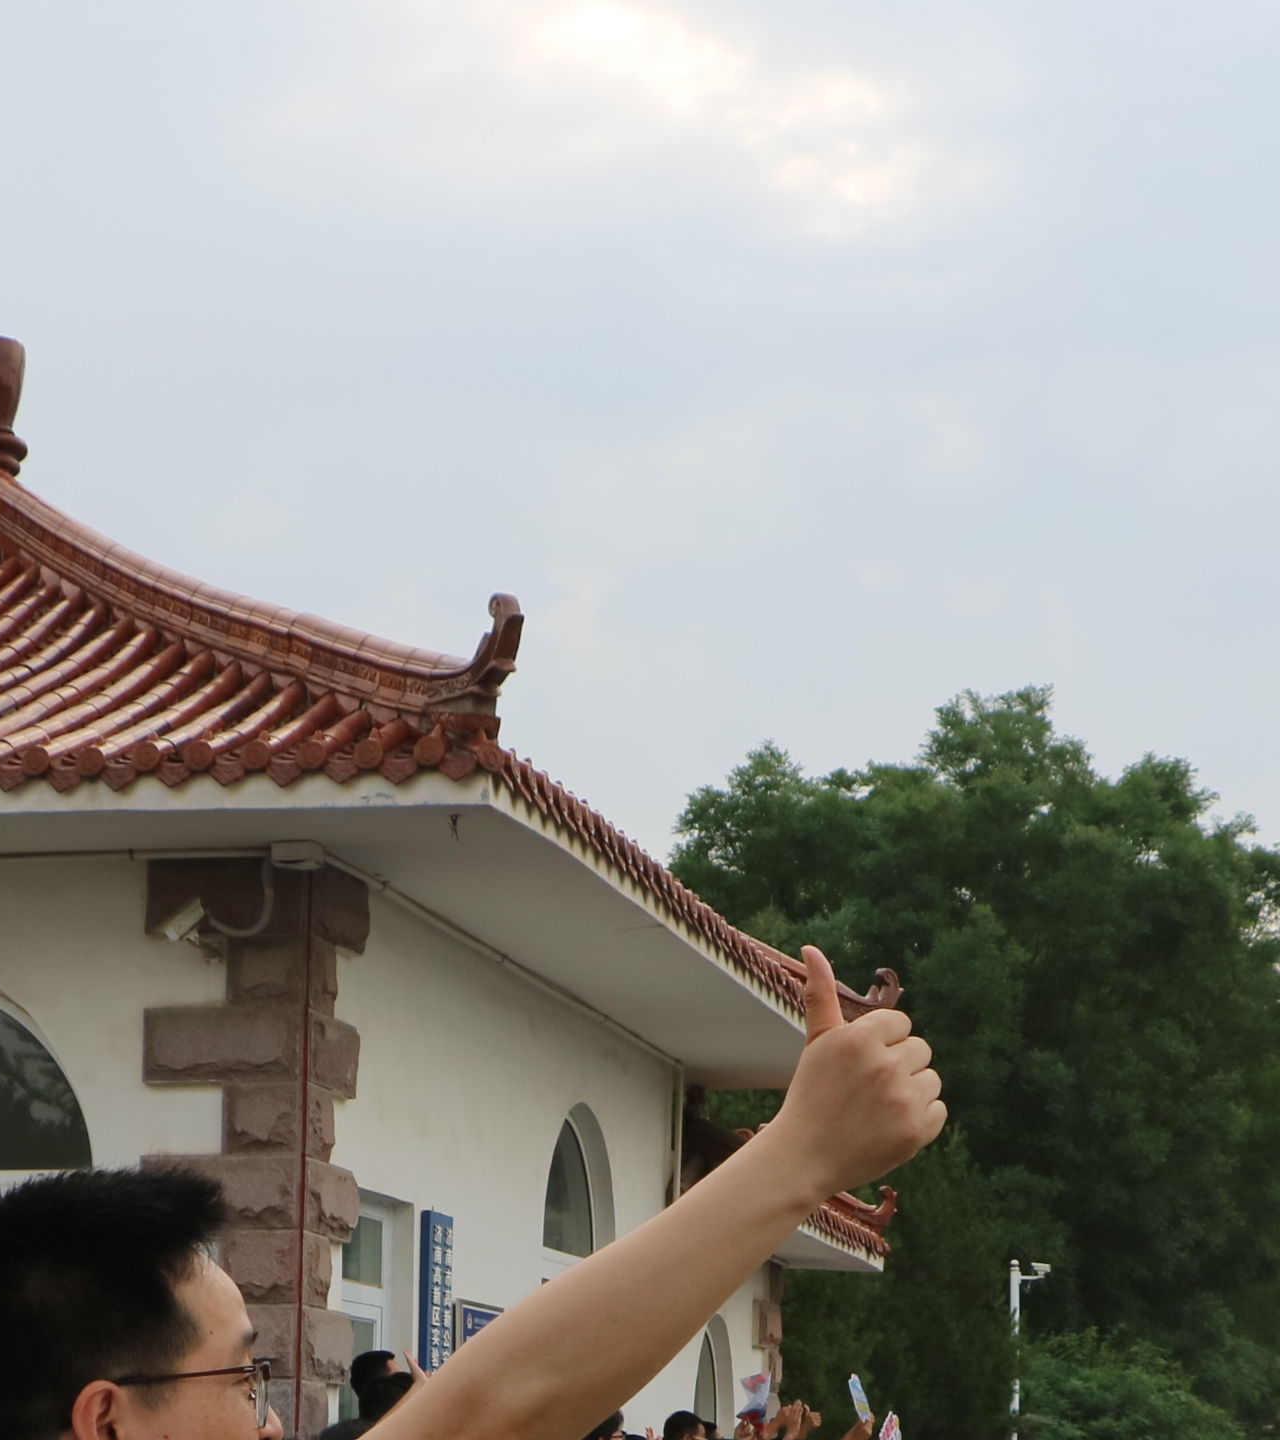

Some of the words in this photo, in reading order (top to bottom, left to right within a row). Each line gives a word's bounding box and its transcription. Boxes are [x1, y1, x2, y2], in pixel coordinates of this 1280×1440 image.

[430, 1224, 443, 1373] 济南高新区实验
